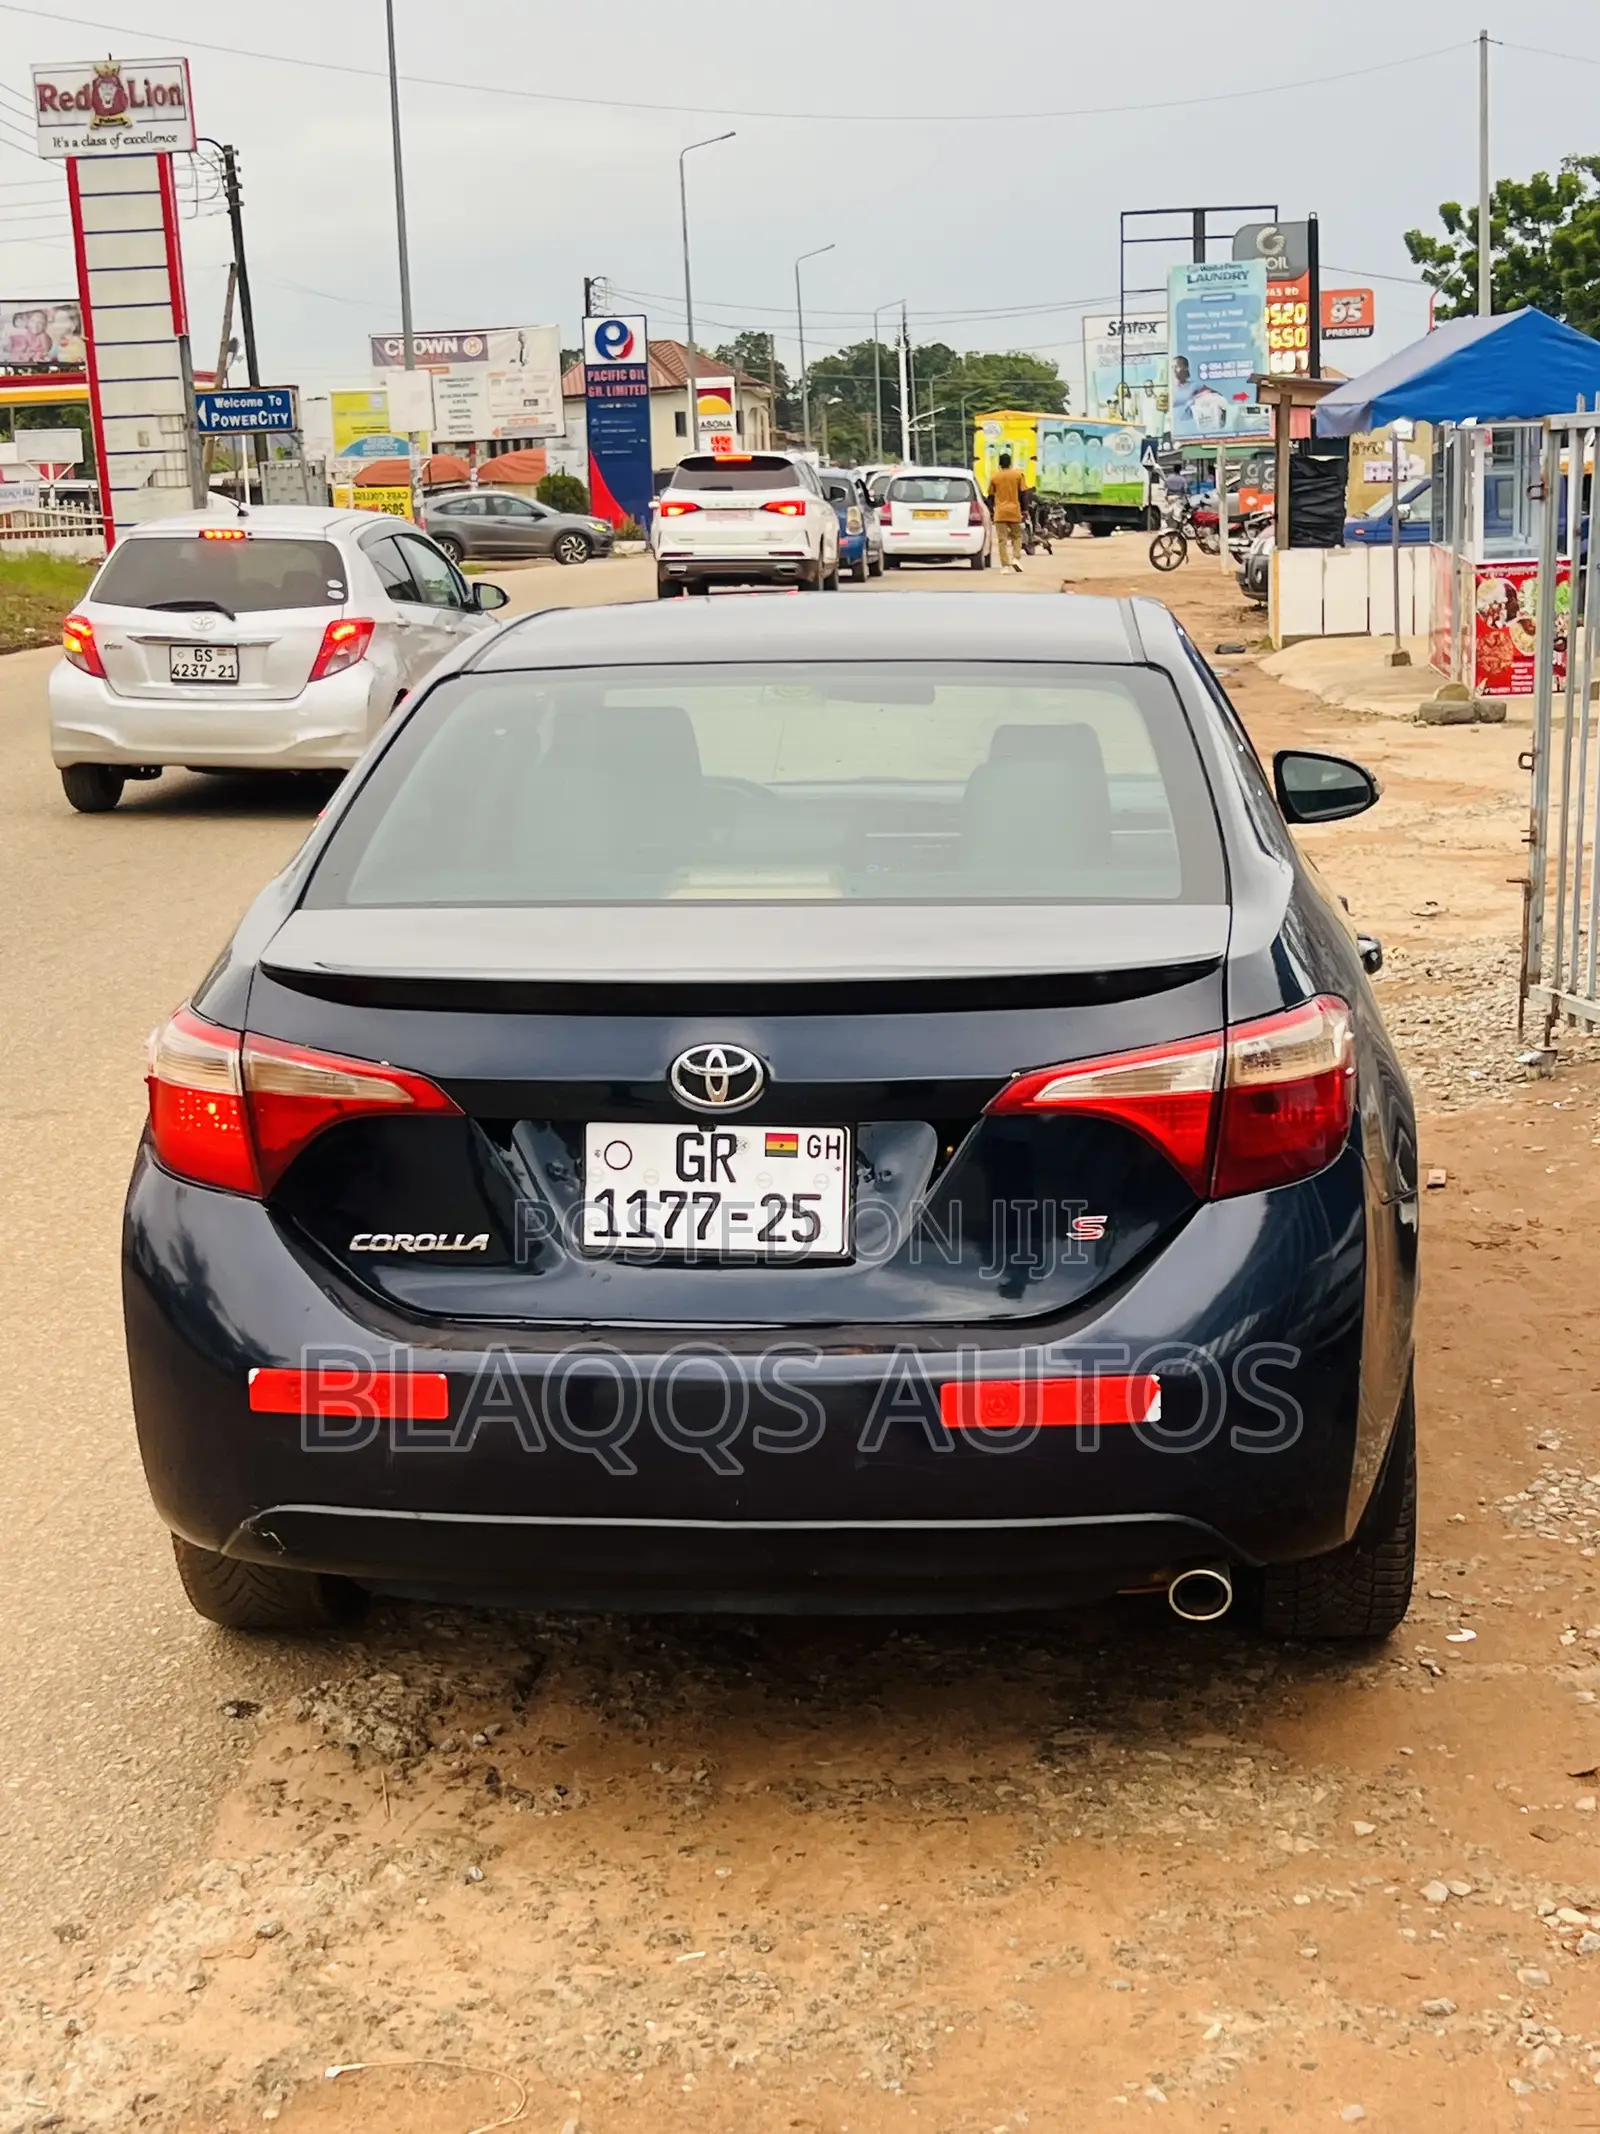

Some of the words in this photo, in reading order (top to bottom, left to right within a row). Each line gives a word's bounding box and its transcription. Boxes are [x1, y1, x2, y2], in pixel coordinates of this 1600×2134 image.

[36, 83, 92, 112] Red
[127, 78, 184, 109] Lion
[52, 136, 70, 148] It's
[71, 139, 79, 147] a
[81, 133, 107, 147] class
[109, 132, 122, 150] of
[123, 131, 178, 146] excellence
[1187, 270, 1250, 284] LAUNDRY
[1331, 300, 1362, 324] 95
[1325, 328, 1370, 338] PREMIUM
[587, 368, 627, 382] PACIFIC
[629, 368, 646, 381] OIL
[606, 383, 648, 397] LIMITED
[214, 397, 263, 409] Welcome
[268, 394, 282, 407] To
[194, 648, 213, 663] GS
[806, 1134, 841, 1160] GH
[676, 1132, 737, 1183] GR
[1065, 1214, 1108, 1241] S
[349, 1232, 490, 1253] COROLLA
